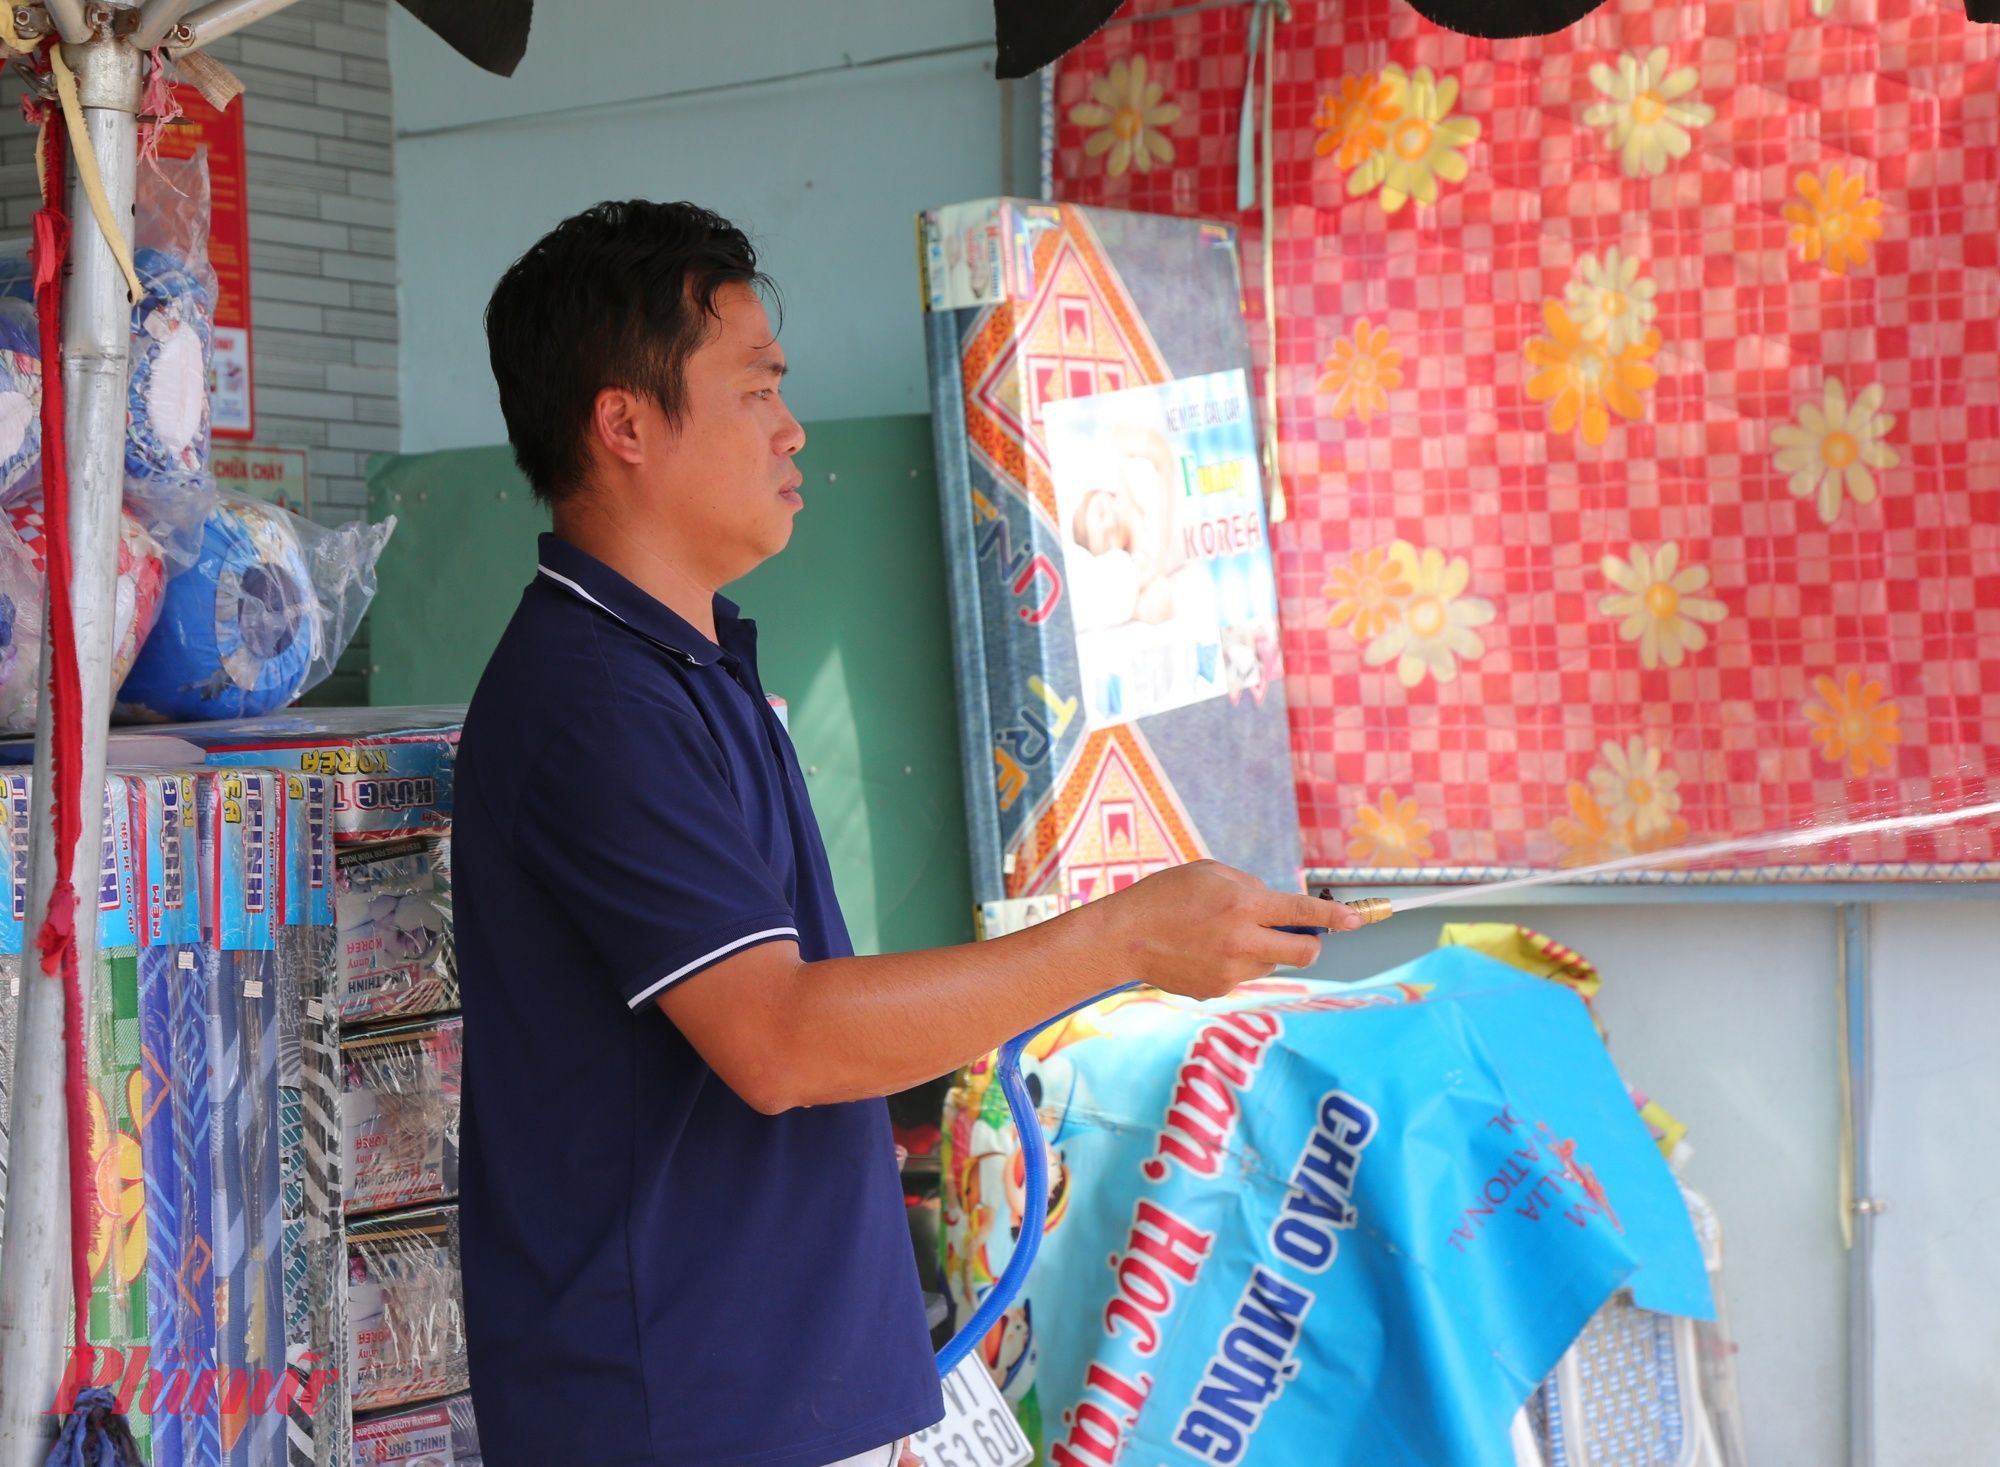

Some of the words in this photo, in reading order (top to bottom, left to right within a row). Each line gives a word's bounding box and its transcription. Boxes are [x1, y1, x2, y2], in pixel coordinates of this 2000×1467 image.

[1183, 509, 1263, 560] KOREA
[301, 748, 389, 775] KOREA
[125, 877, 133, 904] CAO
[346, 938, 382, 955] KOREA
[1446, 1139, 1541, 1254] ATIONAL
[1106, 1199, 1212, 1354] Học
[1175, 1267, 1313, 1465] MỪNG
